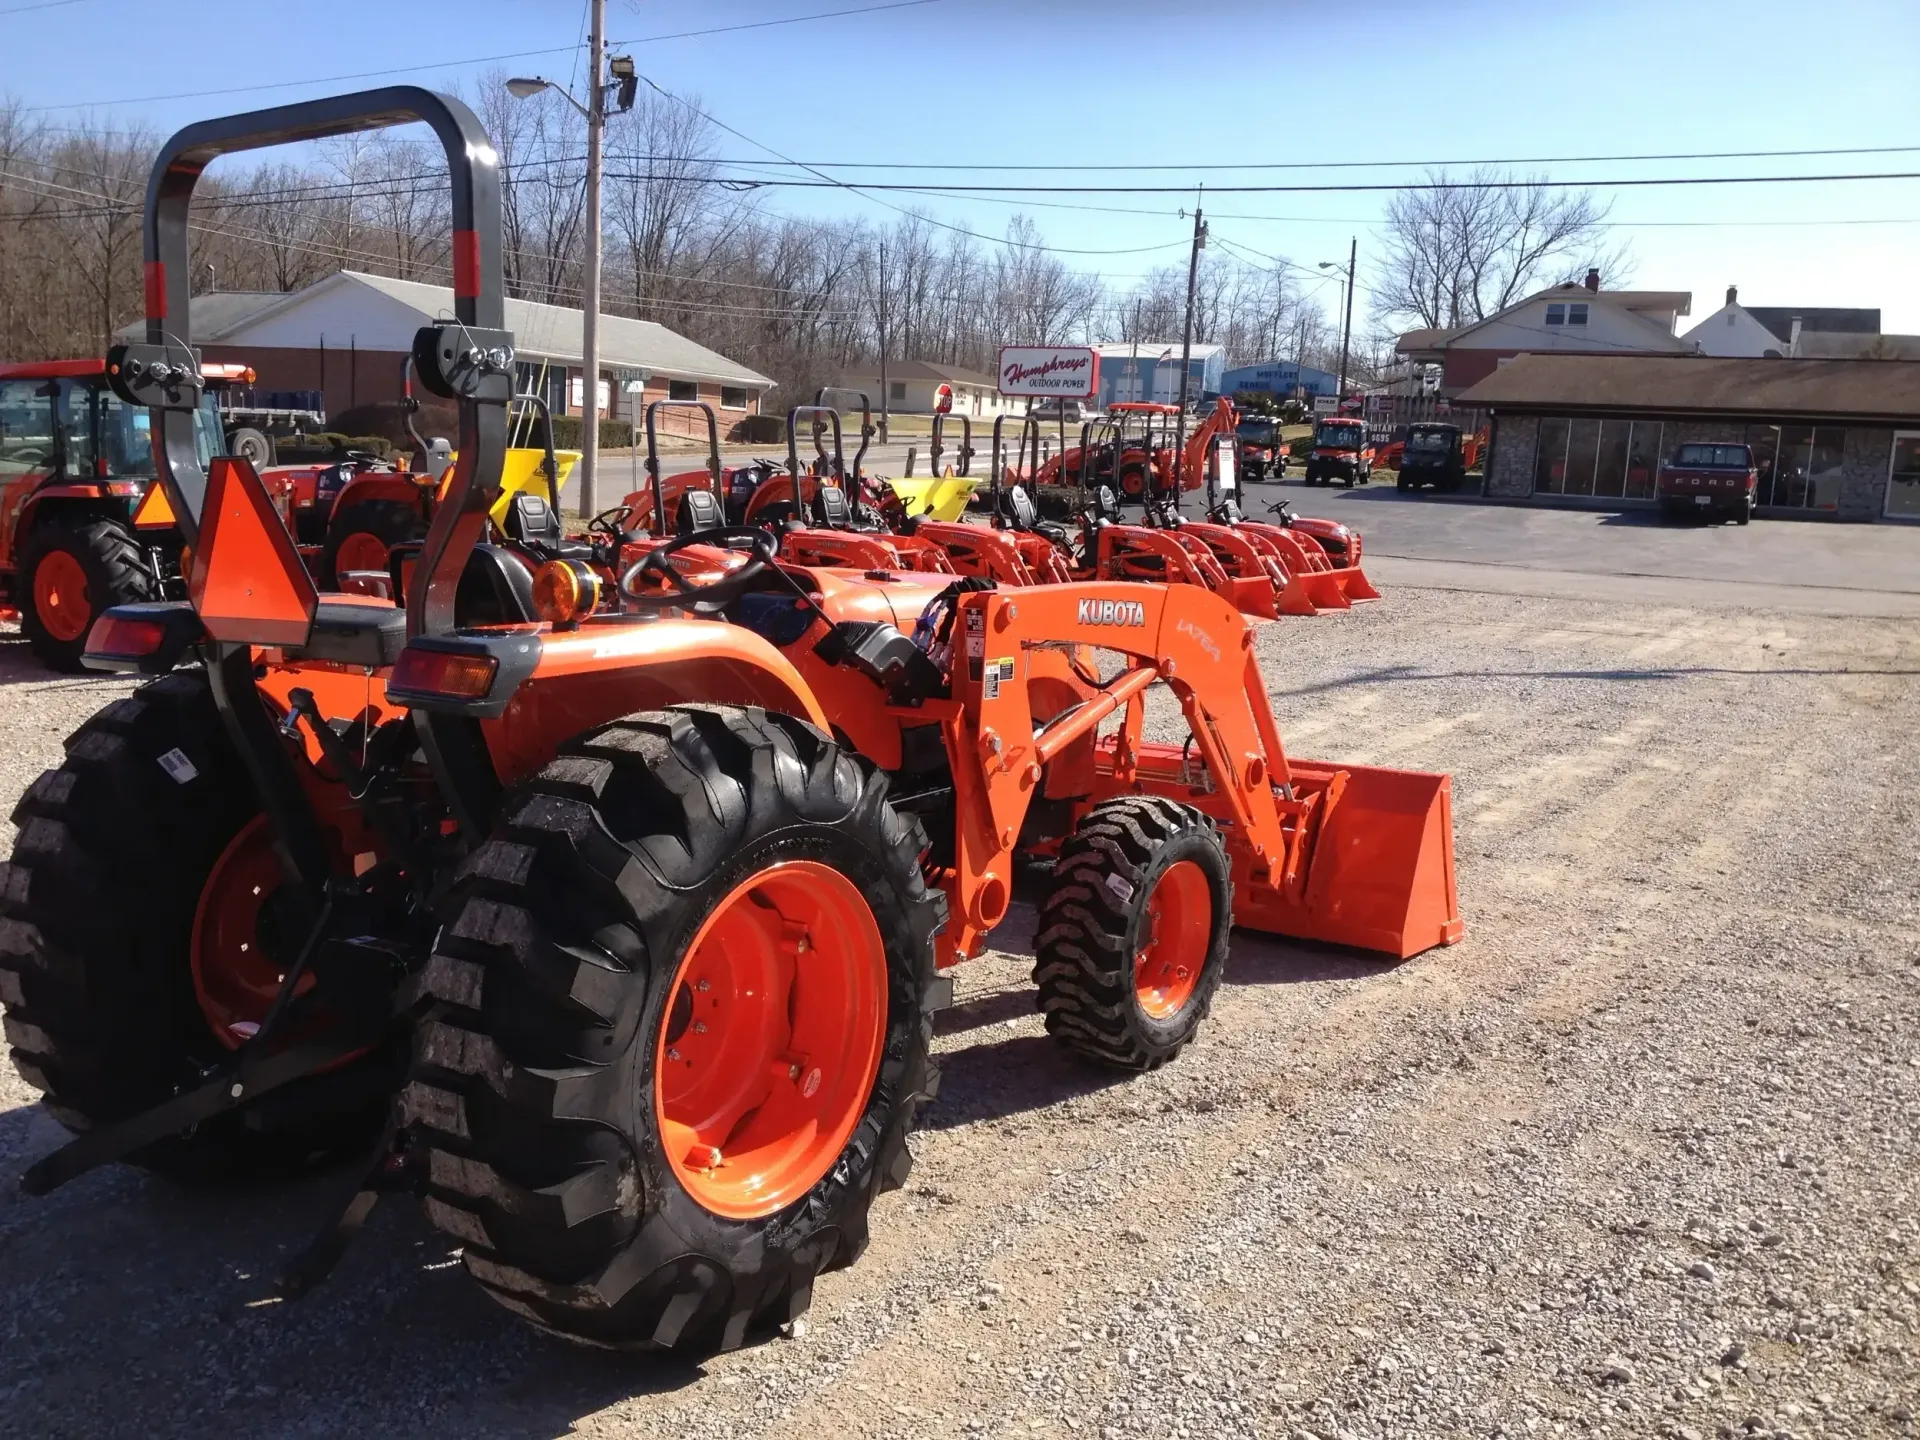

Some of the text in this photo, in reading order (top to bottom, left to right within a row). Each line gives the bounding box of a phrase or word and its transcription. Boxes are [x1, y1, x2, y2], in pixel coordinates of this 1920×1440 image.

[1256, 370, 1299, 379] MUFFLERS
[1029, 378, 1086, 388] OUTDOOR POWER
[1369, 424, 1397, 433] ROTARY
[1675, 479, 1735, 487] FORD
[666, 557, 691, 569] UBOTA
[1078, 598, 1145, 627] KUBOTA
